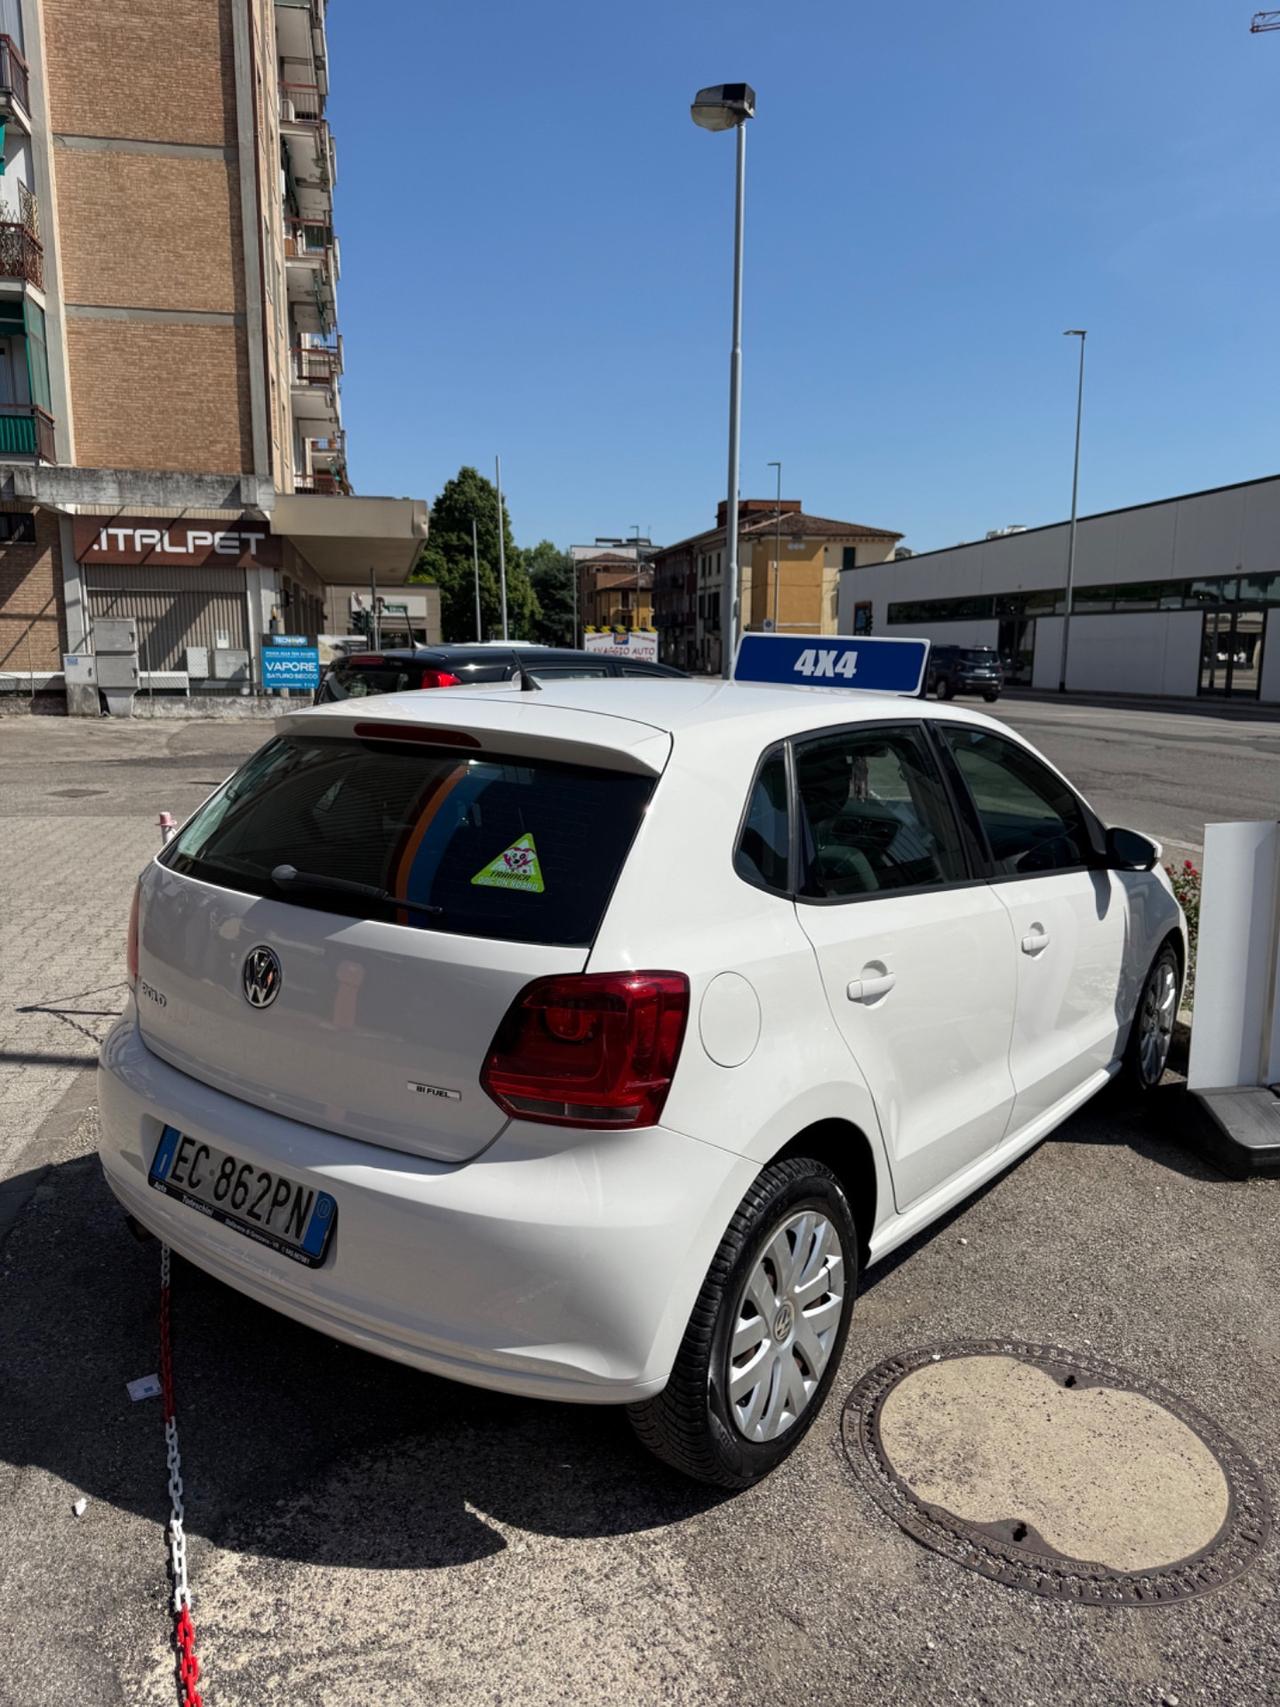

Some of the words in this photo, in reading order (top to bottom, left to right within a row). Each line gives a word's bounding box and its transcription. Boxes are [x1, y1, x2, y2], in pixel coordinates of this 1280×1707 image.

[632, 647, 655, 656] AUTO
[265, 661, 317, 671] VAPORE
[794, 649, 857, 678] 4X4
[427, 1087, 450, 1098] FUEL
